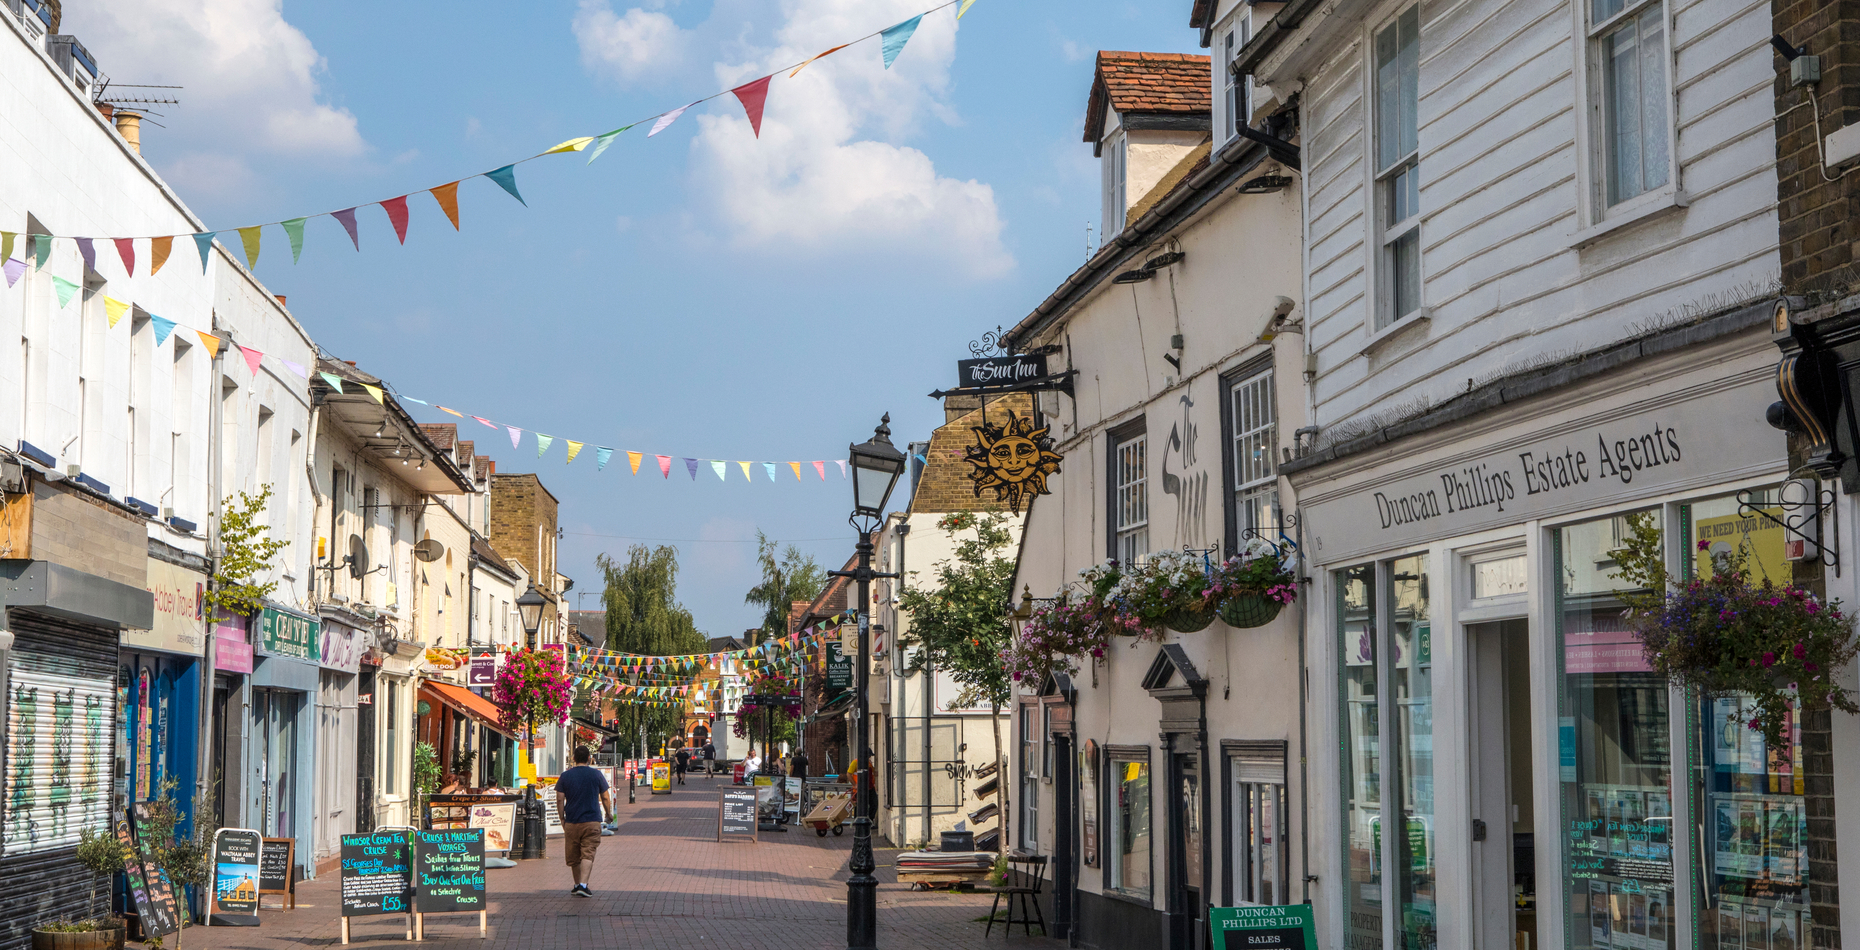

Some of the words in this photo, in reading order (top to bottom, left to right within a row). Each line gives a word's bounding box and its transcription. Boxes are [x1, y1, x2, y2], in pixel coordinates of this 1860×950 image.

[982, 361, 1012, 382] Sun
[1012, 359, 1038, 381] Inn
[1374, 489, 1441, 529] Duncan
[1440, 463, 1514, 513] Phillips
[1519, 446, 1589, 495] Estate
[1599, 422, 1681, 483] Agents
[1699, 526, 1712, 539] WE
[1713, 522, 1734, 537] NEED
[1735, 519, 1758, 534] YOUR
[1315, 536, 1322, 550] 19
[154, 583, 176, 620] Abbey
[343, 835, 370, 846] WINDSOR
[371, 833, 392, 844] CREAM
[391, 833, 405, 844] TEA
[421, 832, 443, 841] CRUISE
[451, 832, 479, 841] MARITIME
[363, 846, 387, 855] CRUISE
[438, 843, 466, 851] VOYAGES
[382, 896, 401, 911] £55
[1236, 907, 1285, 917] DUNCAN
[1222, 918, 1276, 928] PHILLIPS
[1279, 916, 1302, 926] LTD
[1248, 935, 1281, 944] SALES
